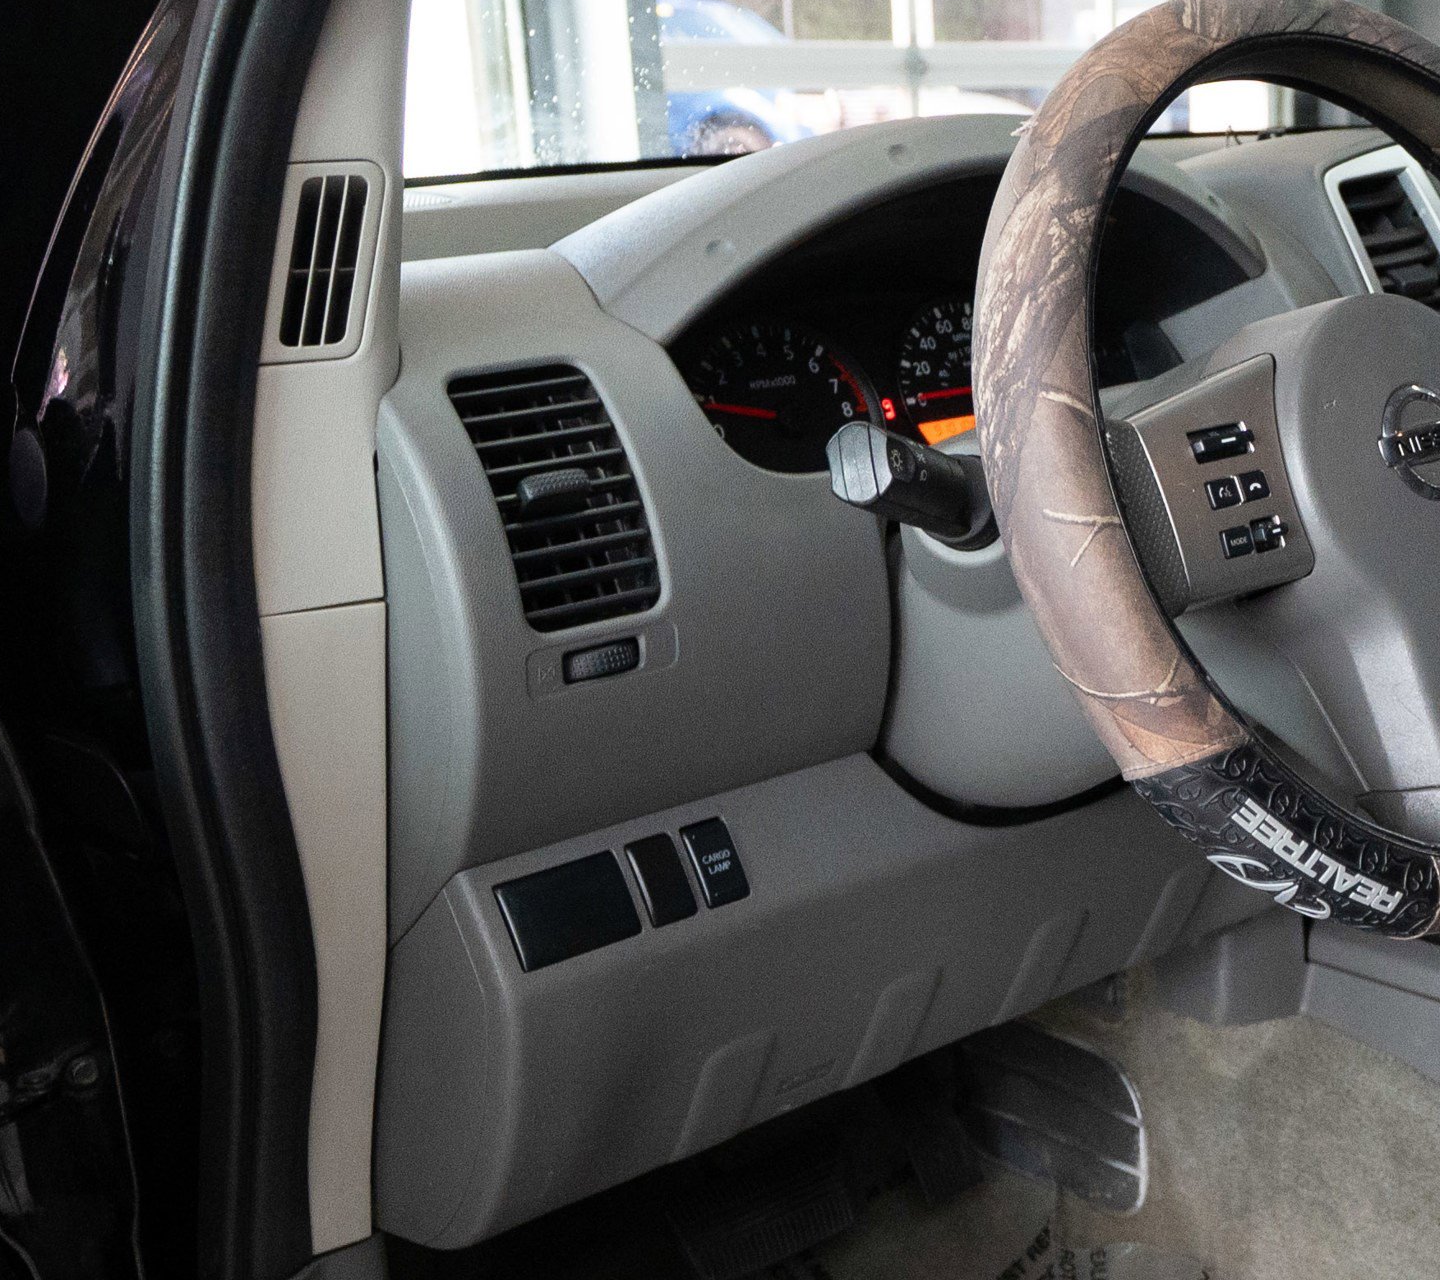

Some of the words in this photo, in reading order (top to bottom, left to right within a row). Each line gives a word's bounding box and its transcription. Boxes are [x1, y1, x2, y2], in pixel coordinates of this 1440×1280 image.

[935, 319, 954, 334] 60
[920, 336, 936, 351] 40
[757, 345, 766, 358] 4
[783, 346, 794, 360] 5
[808, 358, 820, 373] 6
[913, 361, 931, 376] 20
[828, 379, 839, 394] 7
[841, 401, 853, 417] 8
[1230, 535, 1248, 547] MODE
[702, 850, 730, 865] CARGO
[1231, 797, 1404, 915] REALTREE
[708, 860, 730, 875] LAMP
